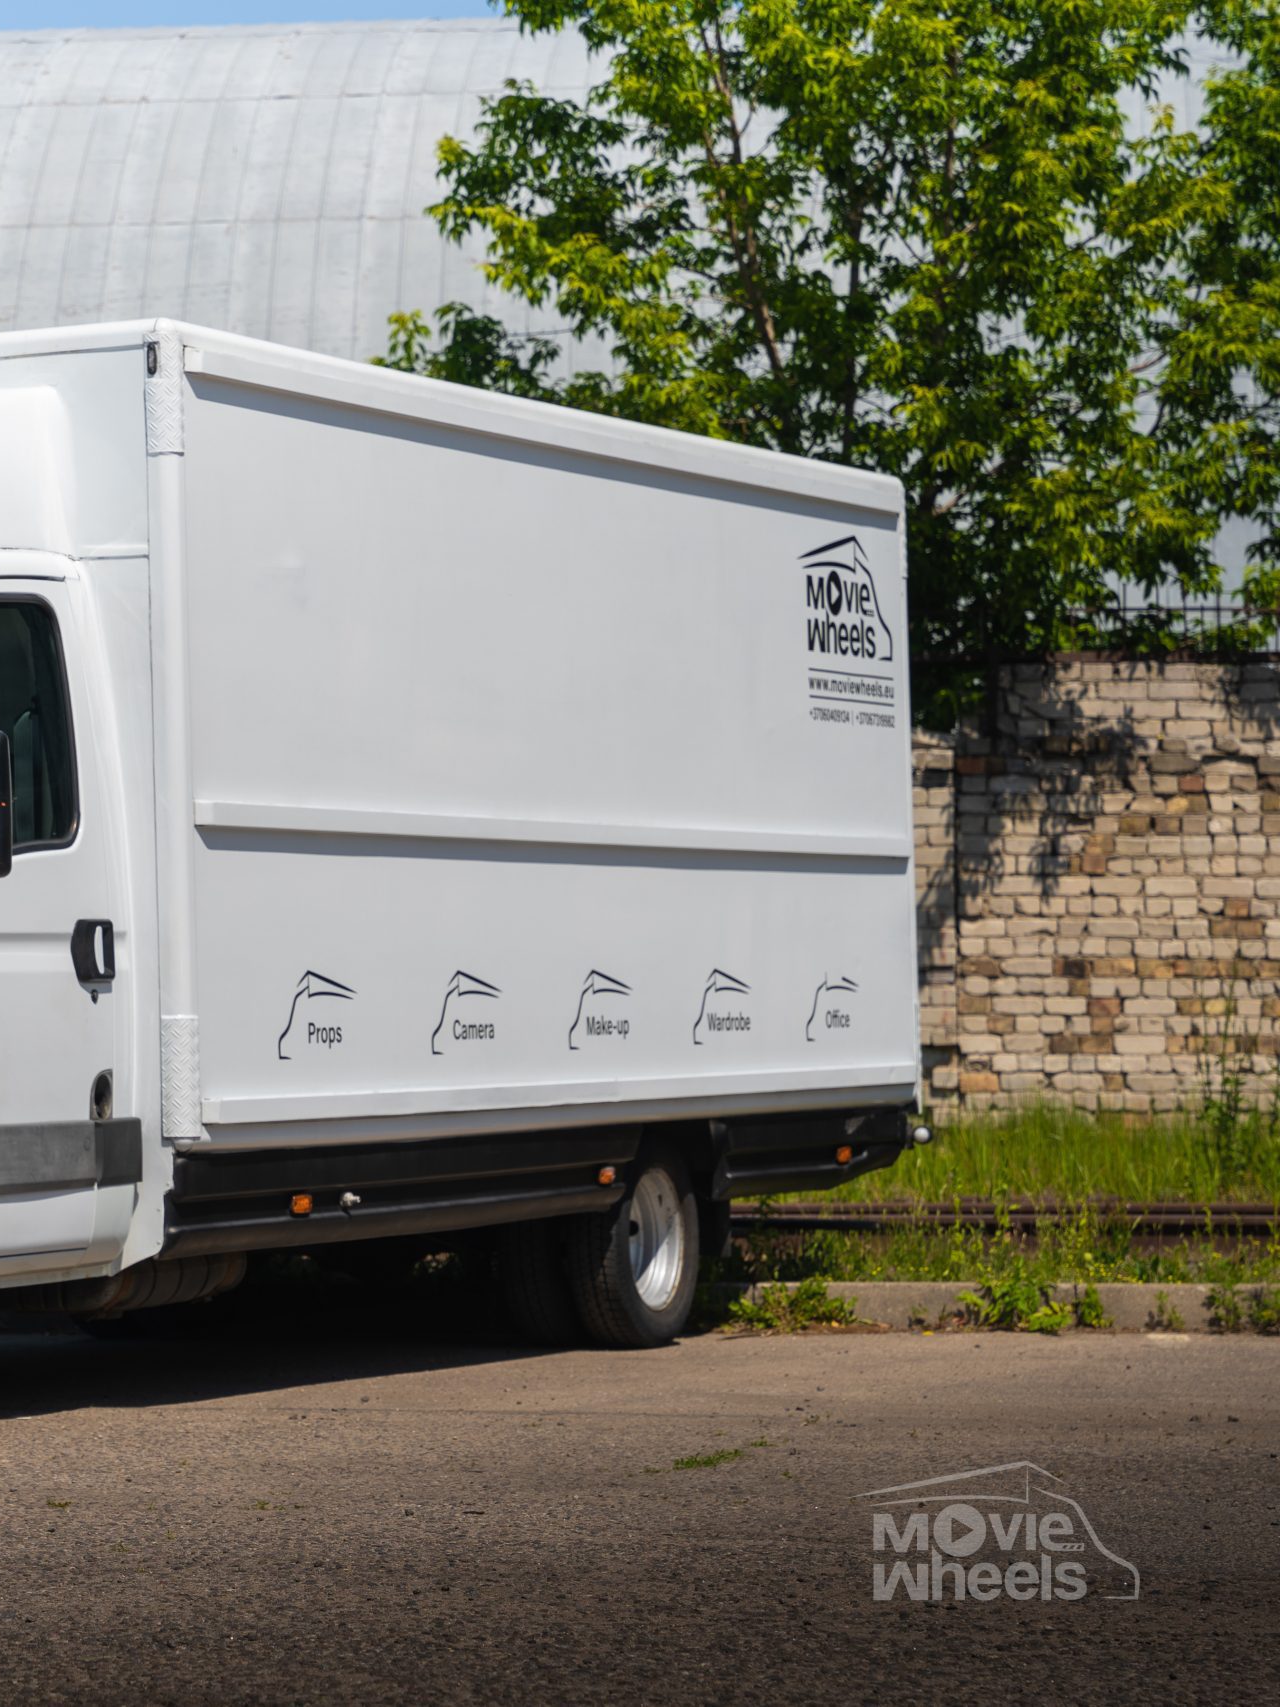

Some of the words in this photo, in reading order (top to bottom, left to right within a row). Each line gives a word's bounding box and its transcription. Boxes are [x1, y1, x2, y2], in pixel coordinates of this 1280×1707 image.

[807, 611, 876, 659] Wheels
[808, 676, 894, 699] www.moviewheels.eu
[452, 1019, 495, 1041] Camera
[585, 1015, 630, 1040] Make-up
[707, 1012, 751, 1032] Wardrobe
[825, 1009, 851, 1029] Office
[307, 1021, 343, 1049] Props
